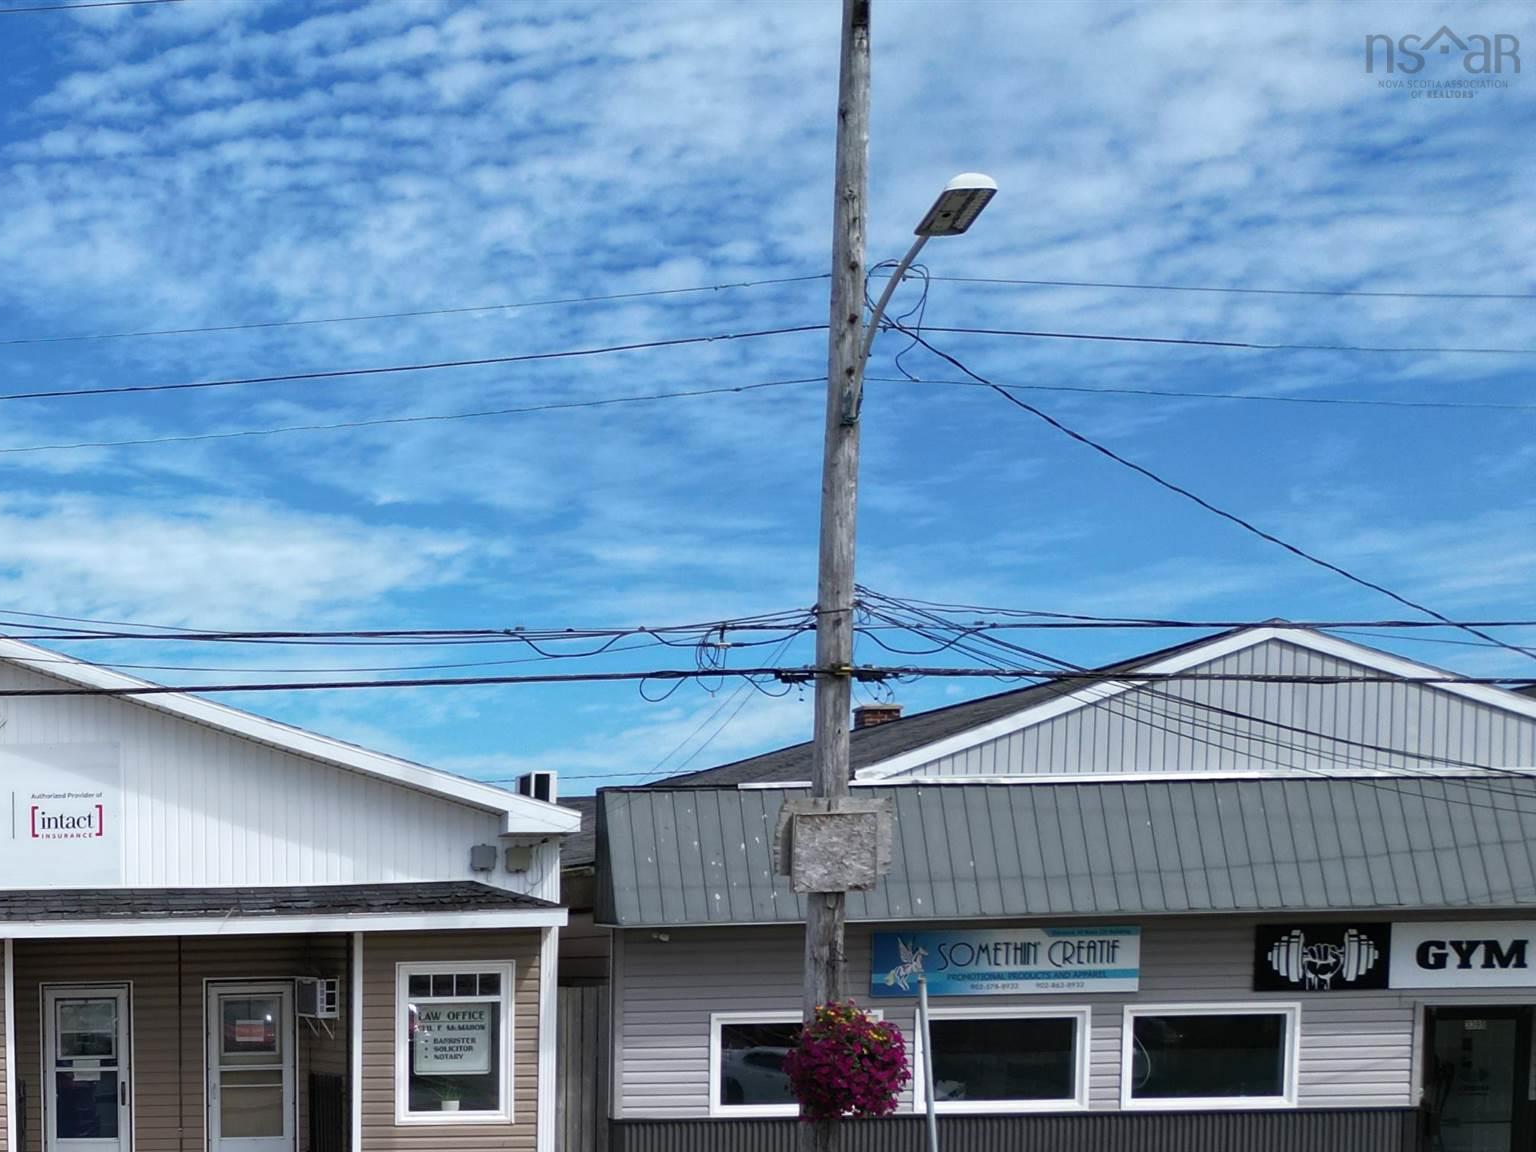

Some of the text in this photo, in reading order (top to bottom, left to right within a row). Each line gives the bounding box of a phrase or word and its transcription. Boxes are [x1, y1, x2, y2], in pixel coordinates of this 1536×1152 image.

[1048, 939, 1120, 968] CREATIF
[1415, 939, 1529, 970] GYM
[947, 970, 1107, 981] PROMOTIONAL PRODUCTS AND APPAREL
[418, 1010, 485, 1021] LAW OFFICE
